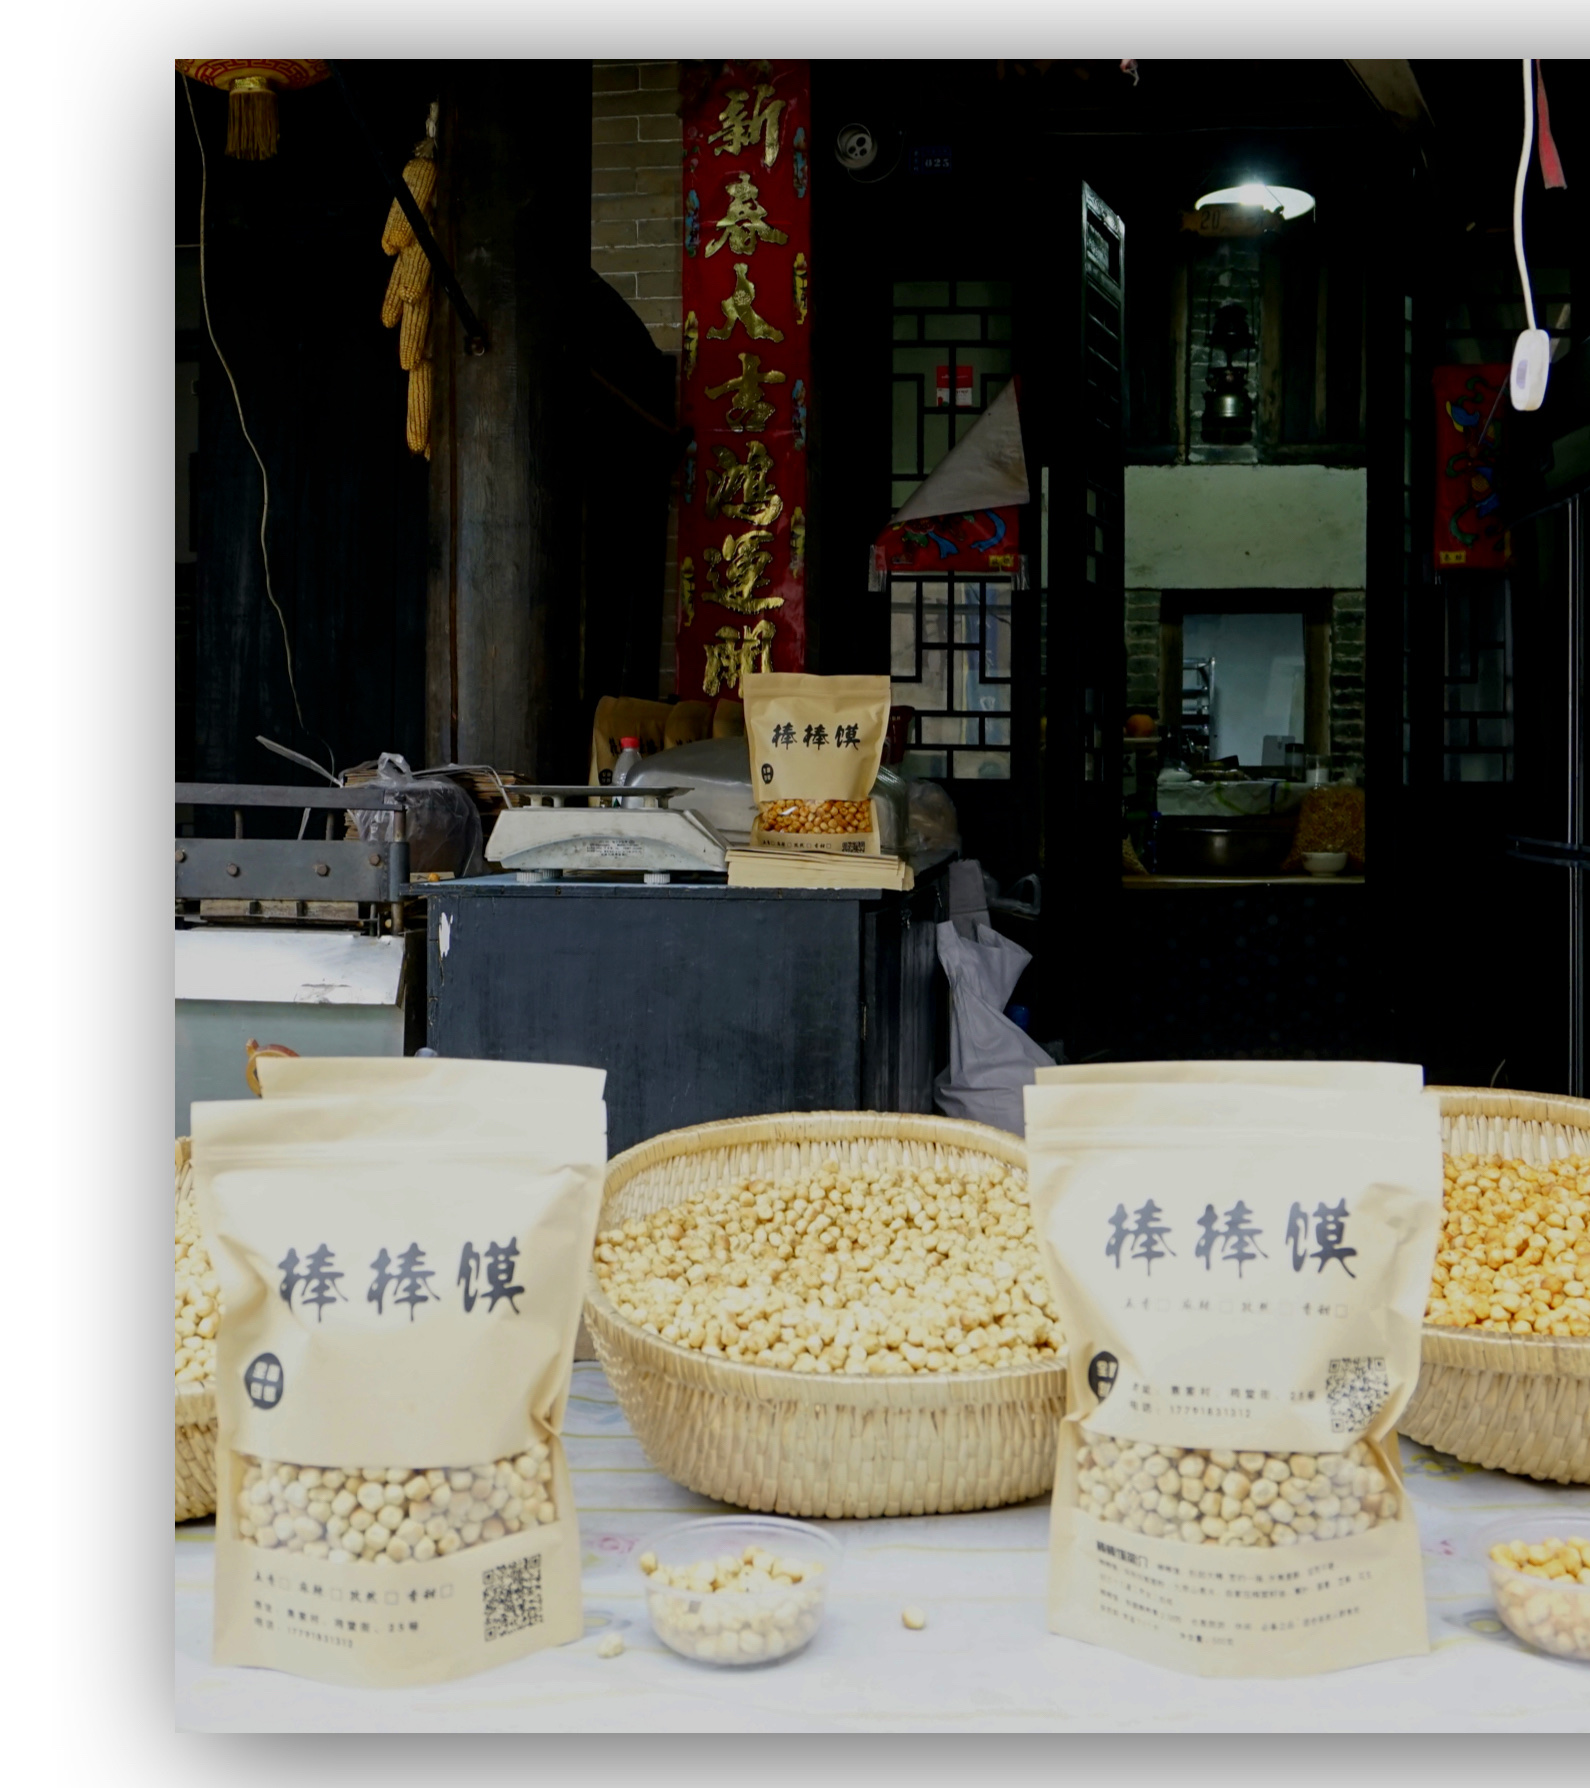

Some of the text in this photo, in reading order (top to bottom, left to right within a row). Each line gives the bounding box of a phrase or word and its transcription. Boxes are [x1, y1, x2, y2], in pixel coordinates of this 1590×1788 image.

[771, 722, 861, 751] 棒棒馍
[1105, 1198, 1358, 1279] 棒棒馍
[278, 1237, 526, 1323] 棒棒馍
